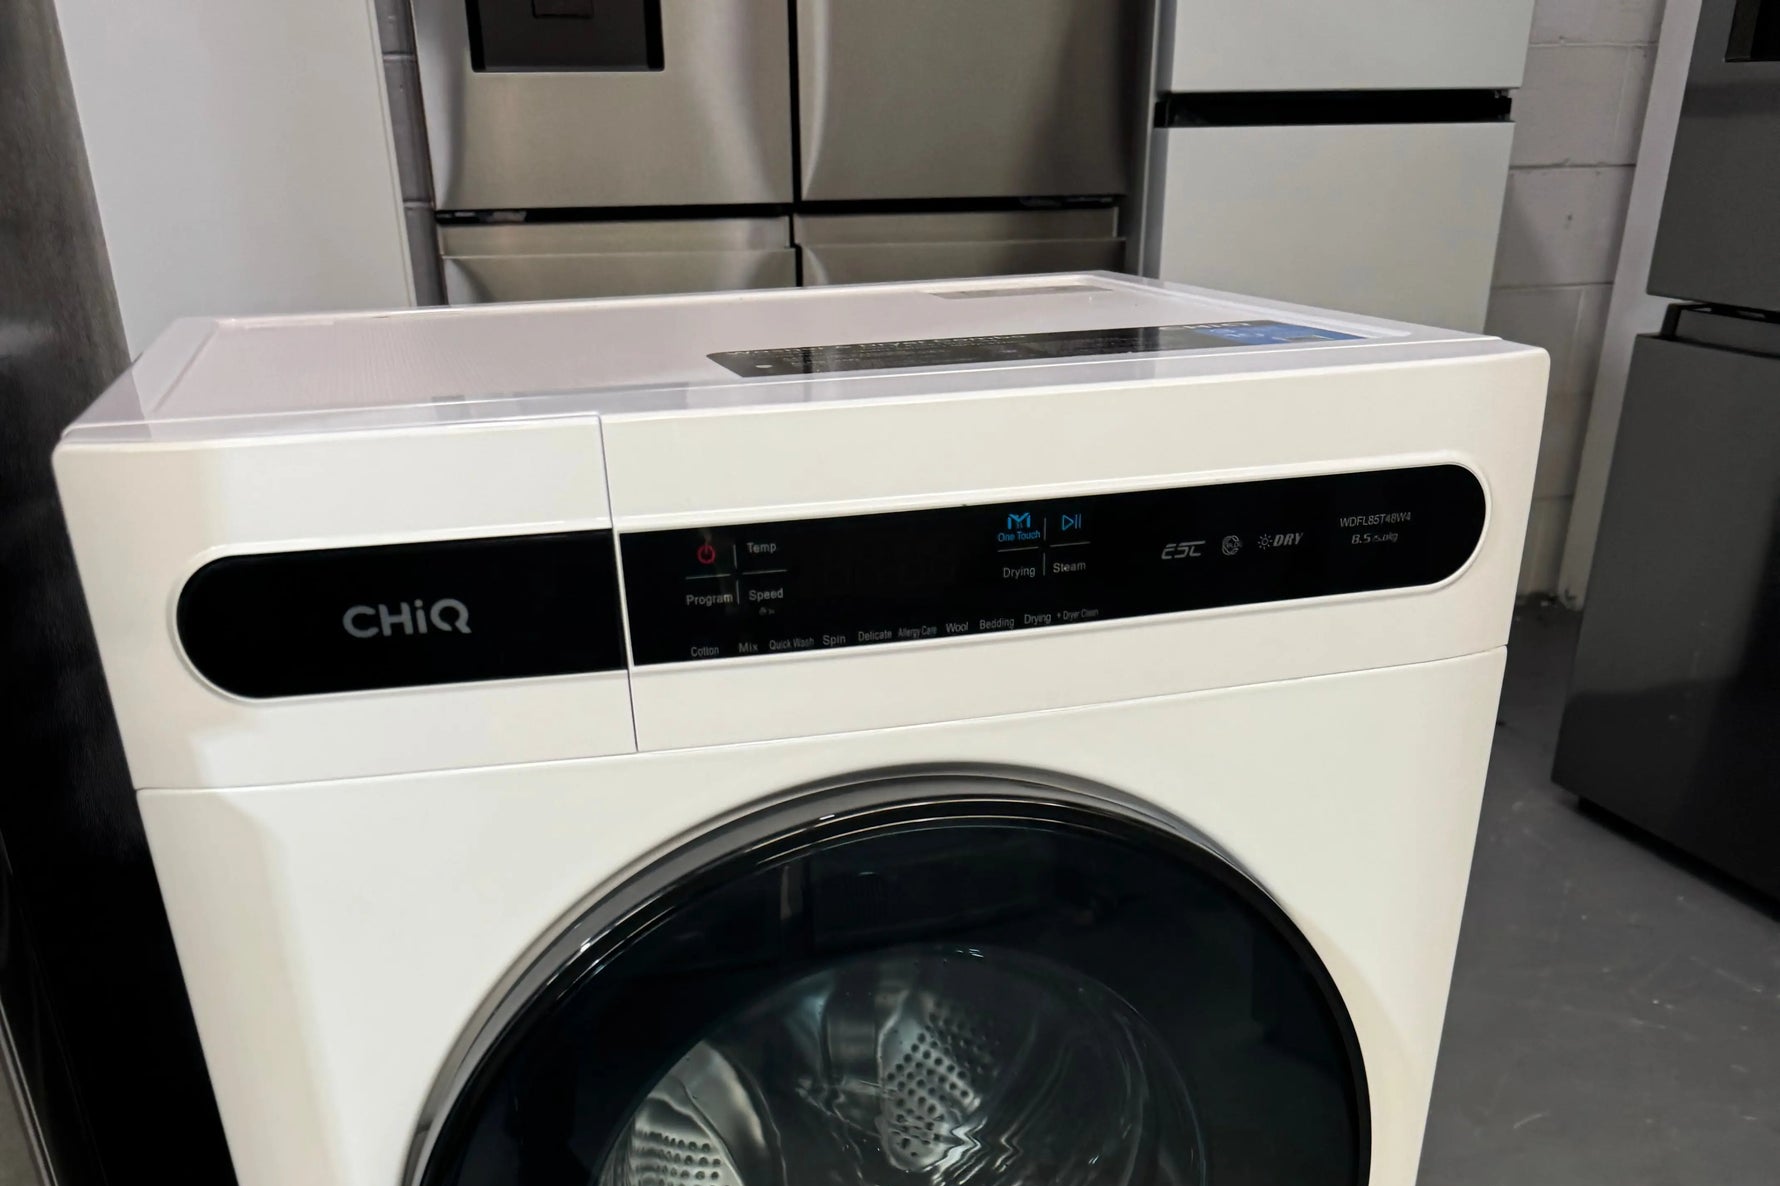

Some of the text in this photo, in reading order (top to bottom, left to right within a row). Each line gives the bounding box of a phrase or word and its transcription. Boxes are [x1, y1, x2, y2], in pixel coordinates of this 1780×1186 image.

[997, 530, 1041, 542] One Touch
[1273, 532, 1304, 547] DRY
[747, 541, 777, 555] Temp
[1003, 566, 1036, 580] Drying
[1053, 561, 1087, 574] Steam
[686, 592, 734, 607] Program
[749, 587, 784, 602] Speed
[342, 598, 473, 639] CHiQ
[979, 617, 1015, 631] Bedding
[1024, 612, 1052, 626] Drying
[898, 624, 938, 640] Allergy Care
[946, 621, 969, 633] Wool
[822, 634, 846, 648] Spin
[858, 629, 893, 642] Delicate
[738, 641, 759, 653] Mix
[769, 636, 815, 651] Quick Wash
[691, 645, 720, 658] Cotton
